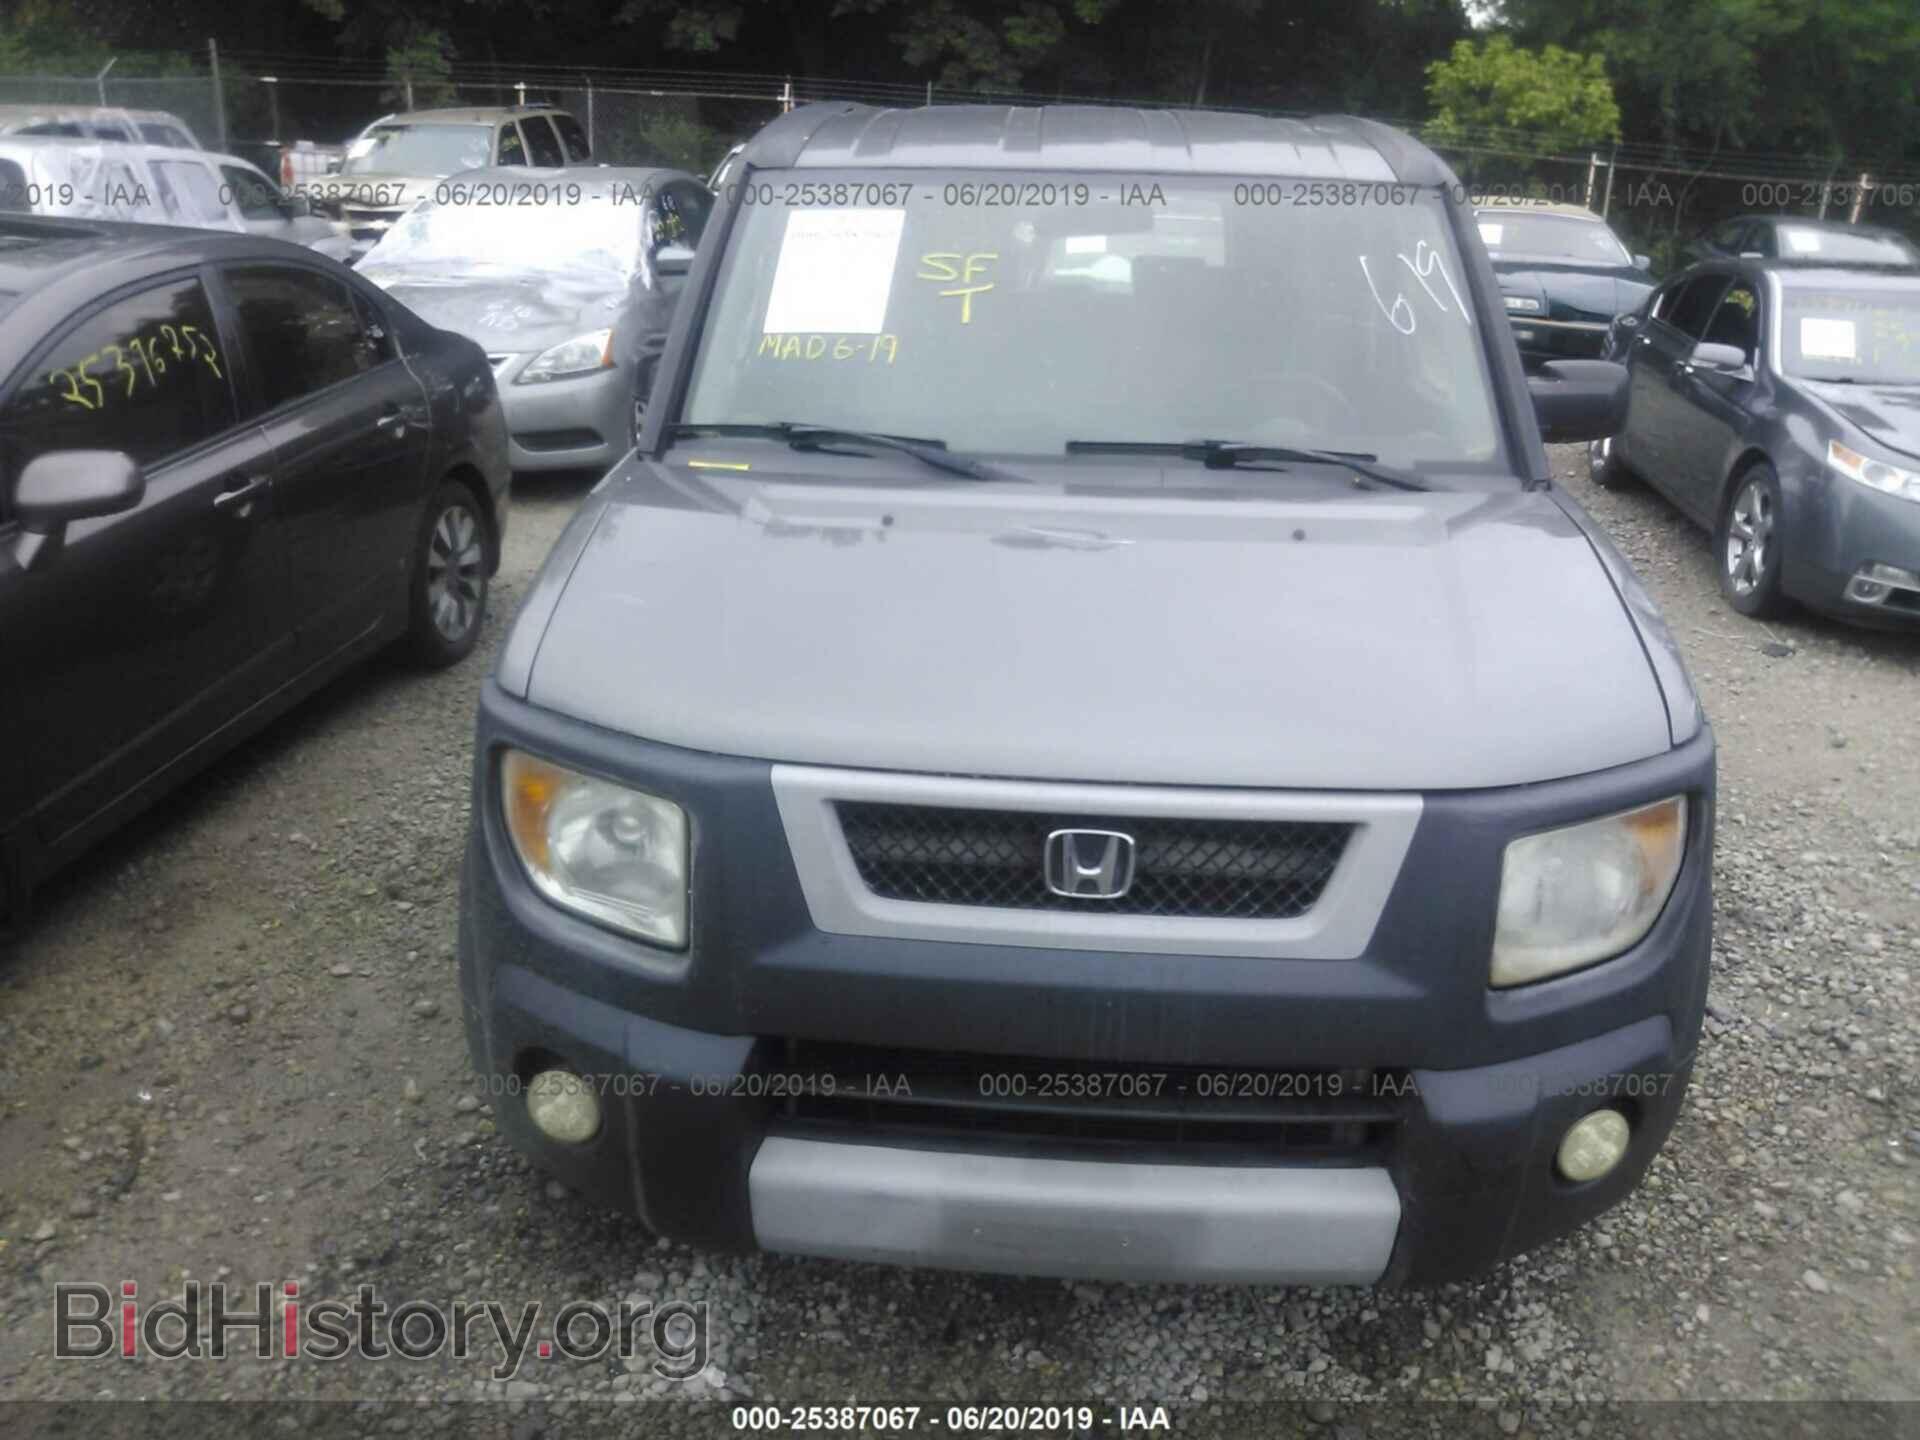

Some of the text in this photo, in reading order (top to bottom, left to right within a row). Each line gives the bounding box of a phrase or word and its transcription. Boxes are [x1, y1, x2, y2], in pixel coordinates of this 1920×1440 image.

[917, 253, 999, 283] SF
[939, 284, 994, 324] T
[757, 335, 897, 365] MAD 6-19
